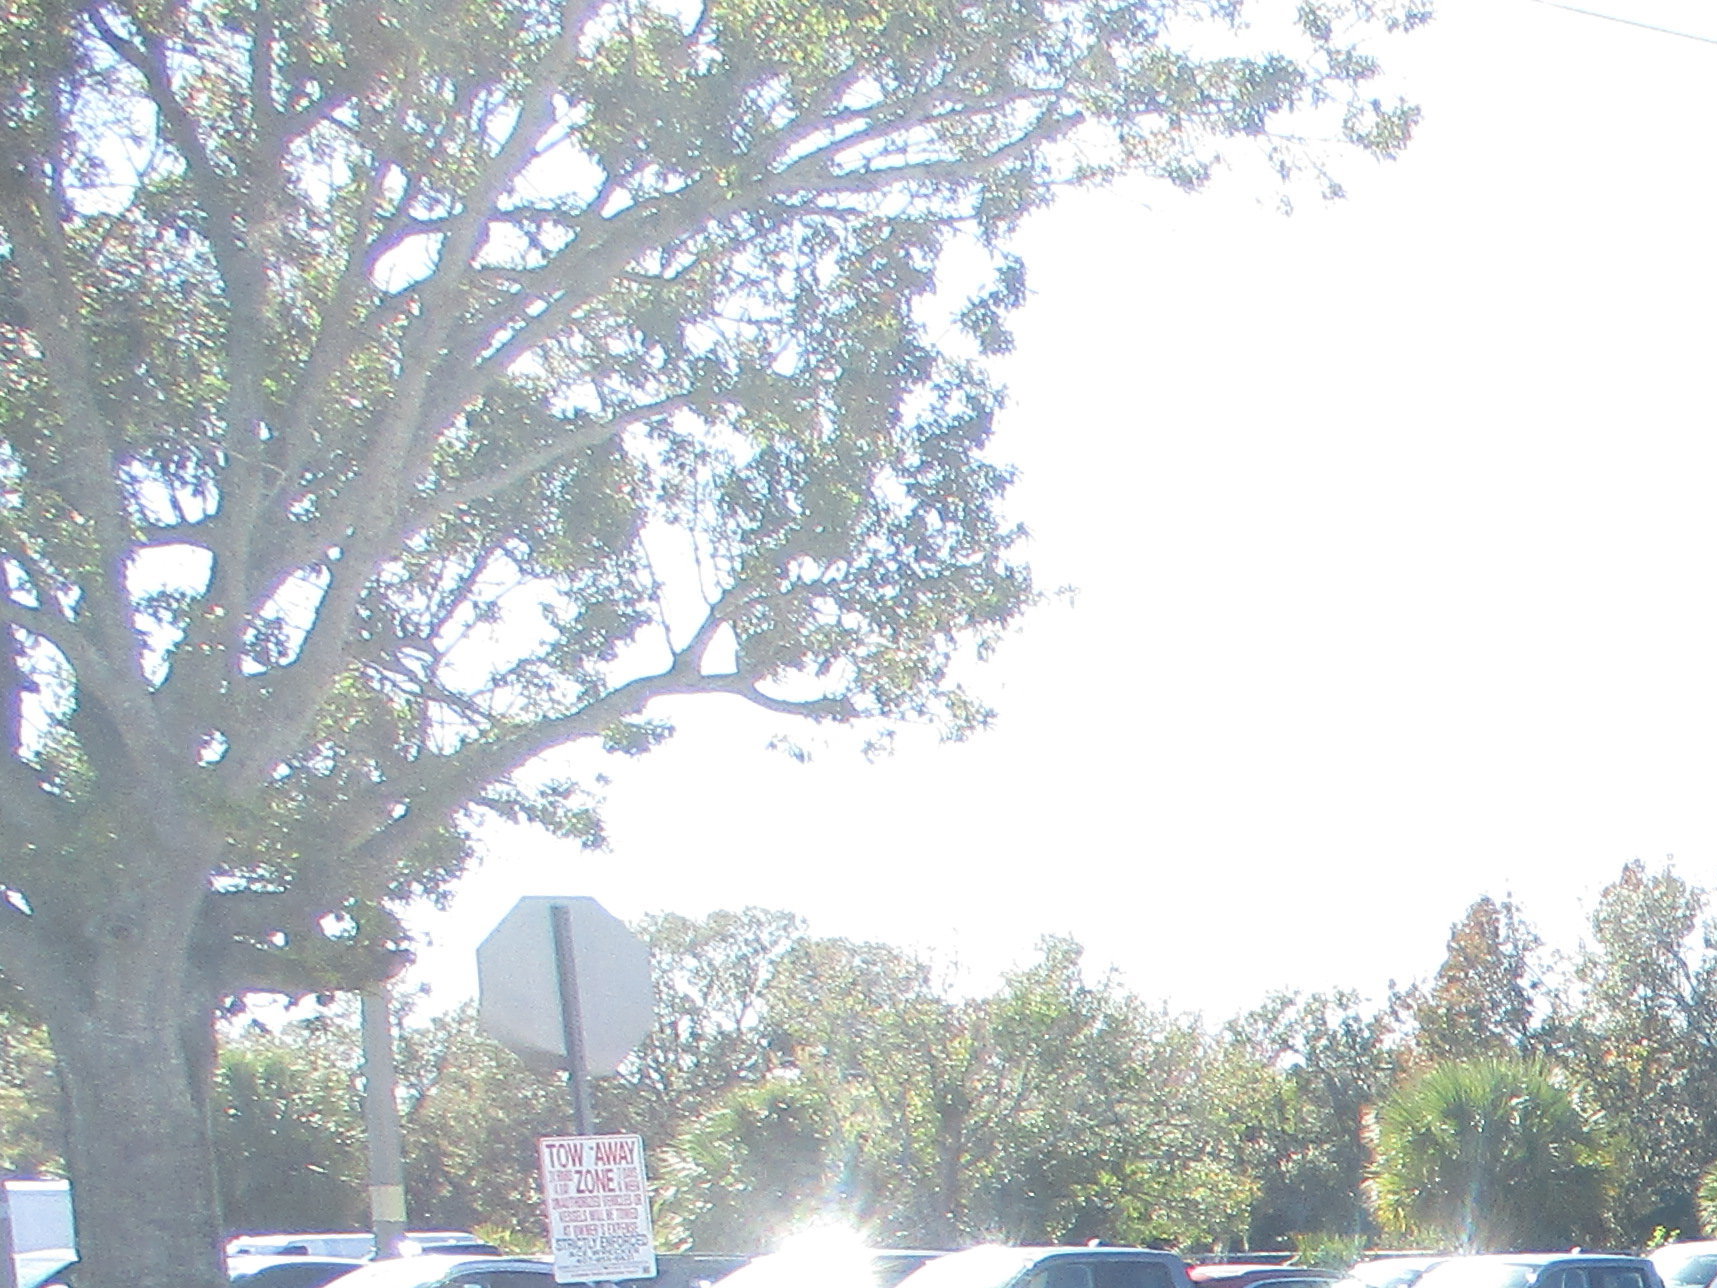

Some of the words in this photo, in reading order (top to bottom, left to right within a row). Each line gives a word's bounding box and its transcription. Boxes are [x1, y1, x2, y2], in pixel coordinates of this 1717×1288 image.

[546, 1143, 583, 1168] TOW
[595, 1141, 635, 1166] AWAY
[574, 1169, 616, 1194] ZONE
